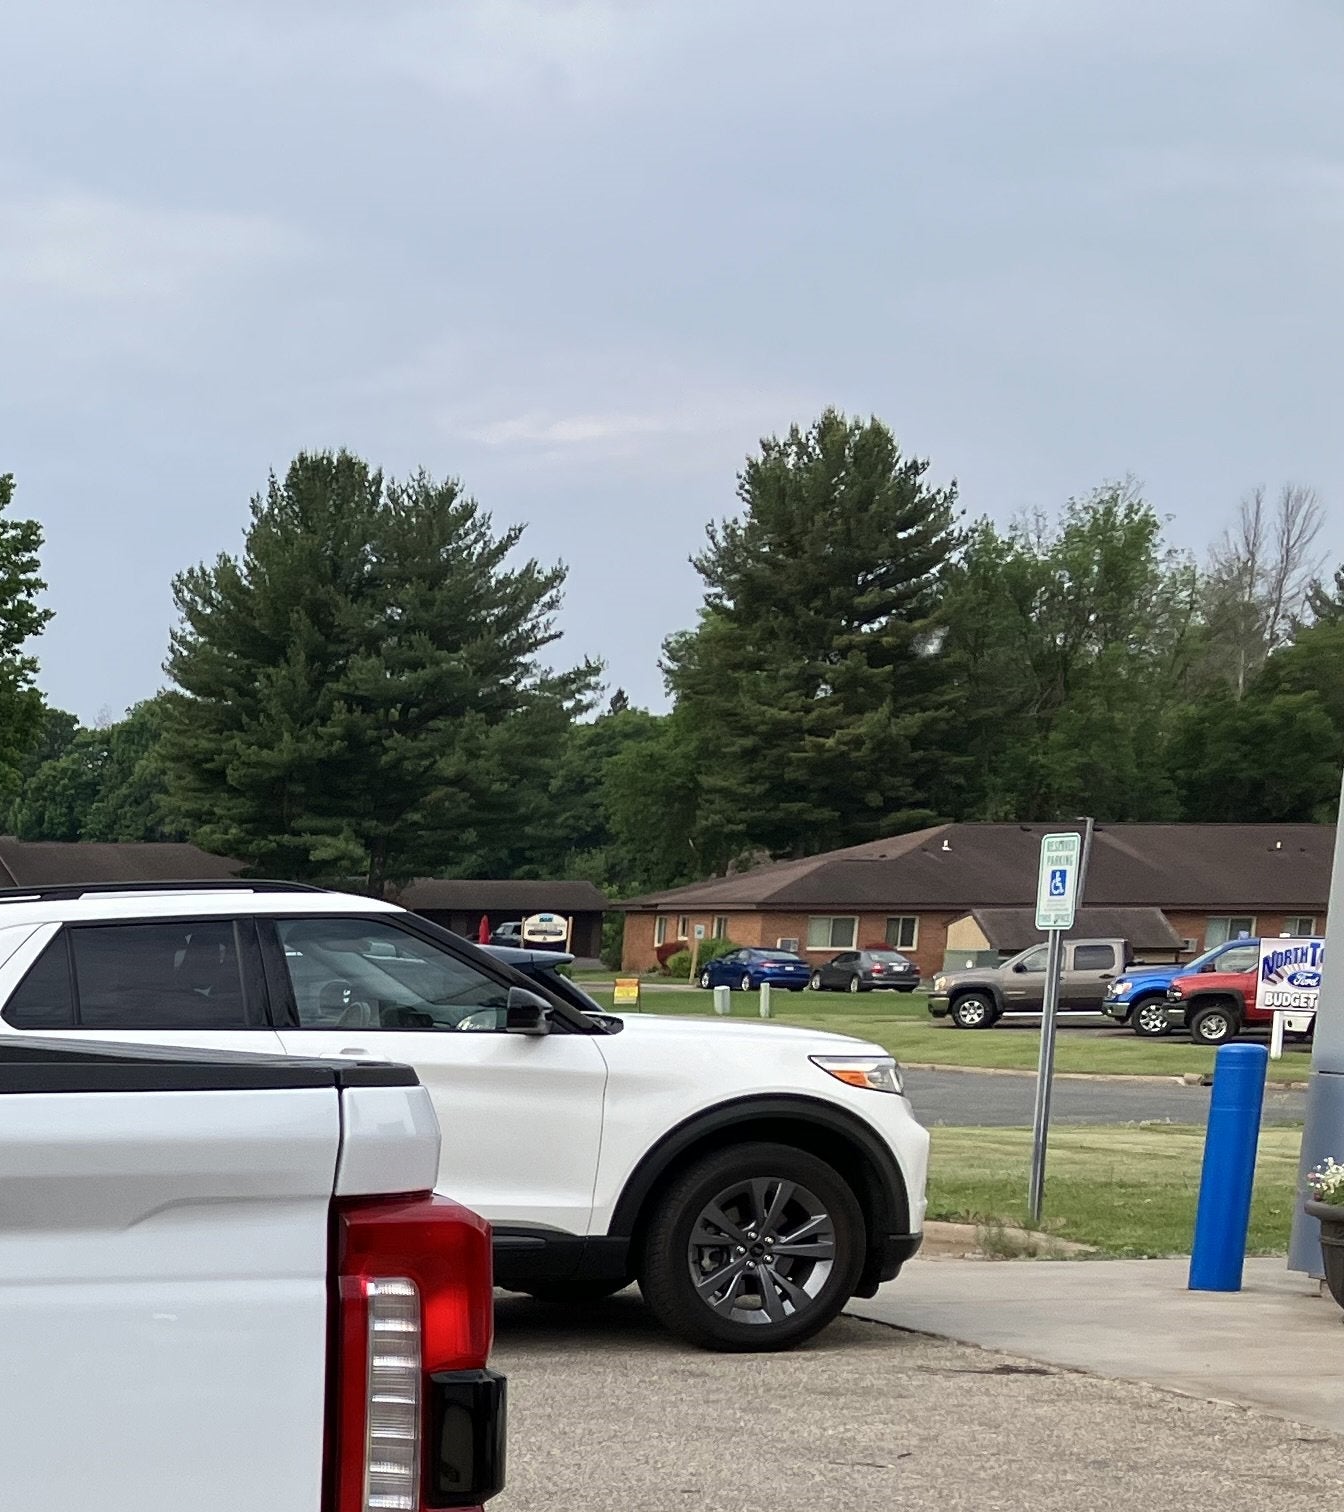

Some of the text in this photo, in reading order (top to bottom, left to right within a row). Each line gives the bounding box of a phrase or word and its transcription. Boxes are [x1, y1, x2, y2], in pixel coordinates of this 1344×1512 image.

[1262, 945, 1309, 982] NORTH
[1293, 972, 1320, 987] Ford
[1265, 991, 1318, 1009] BUDGET
